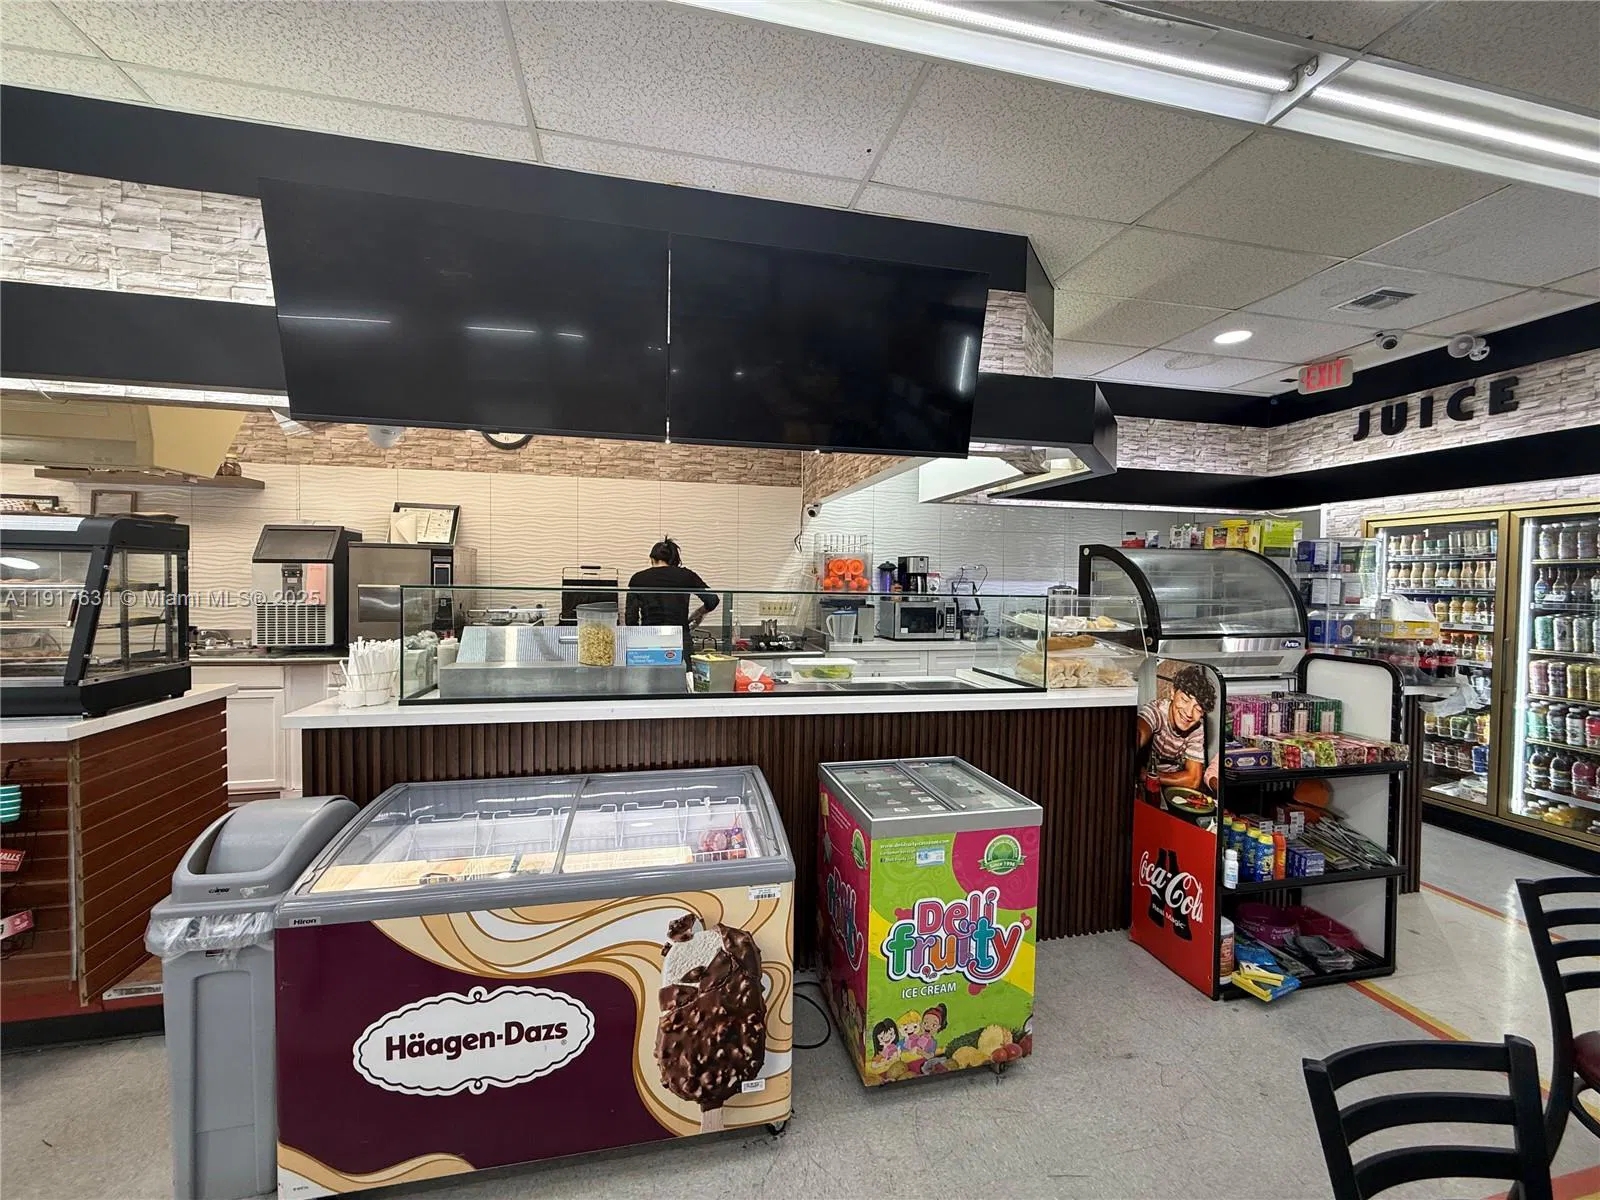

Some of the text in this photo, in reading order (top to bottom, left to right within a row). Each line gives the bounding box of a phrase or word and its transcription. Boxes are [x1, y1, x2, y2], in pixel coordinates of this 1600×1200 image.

[1306, 359, 1345, 392] EXIT
[1353, 376, 1519, 441] JUICE
[1139, 850, 1203, 923] Coca-Cola
[293, 918, 317, 926] Hiron
[917, 889, 997, 939] Deli
[886, 922, 1022, 981] fruity
[902, 982, 957, 999] ICE CREAM
